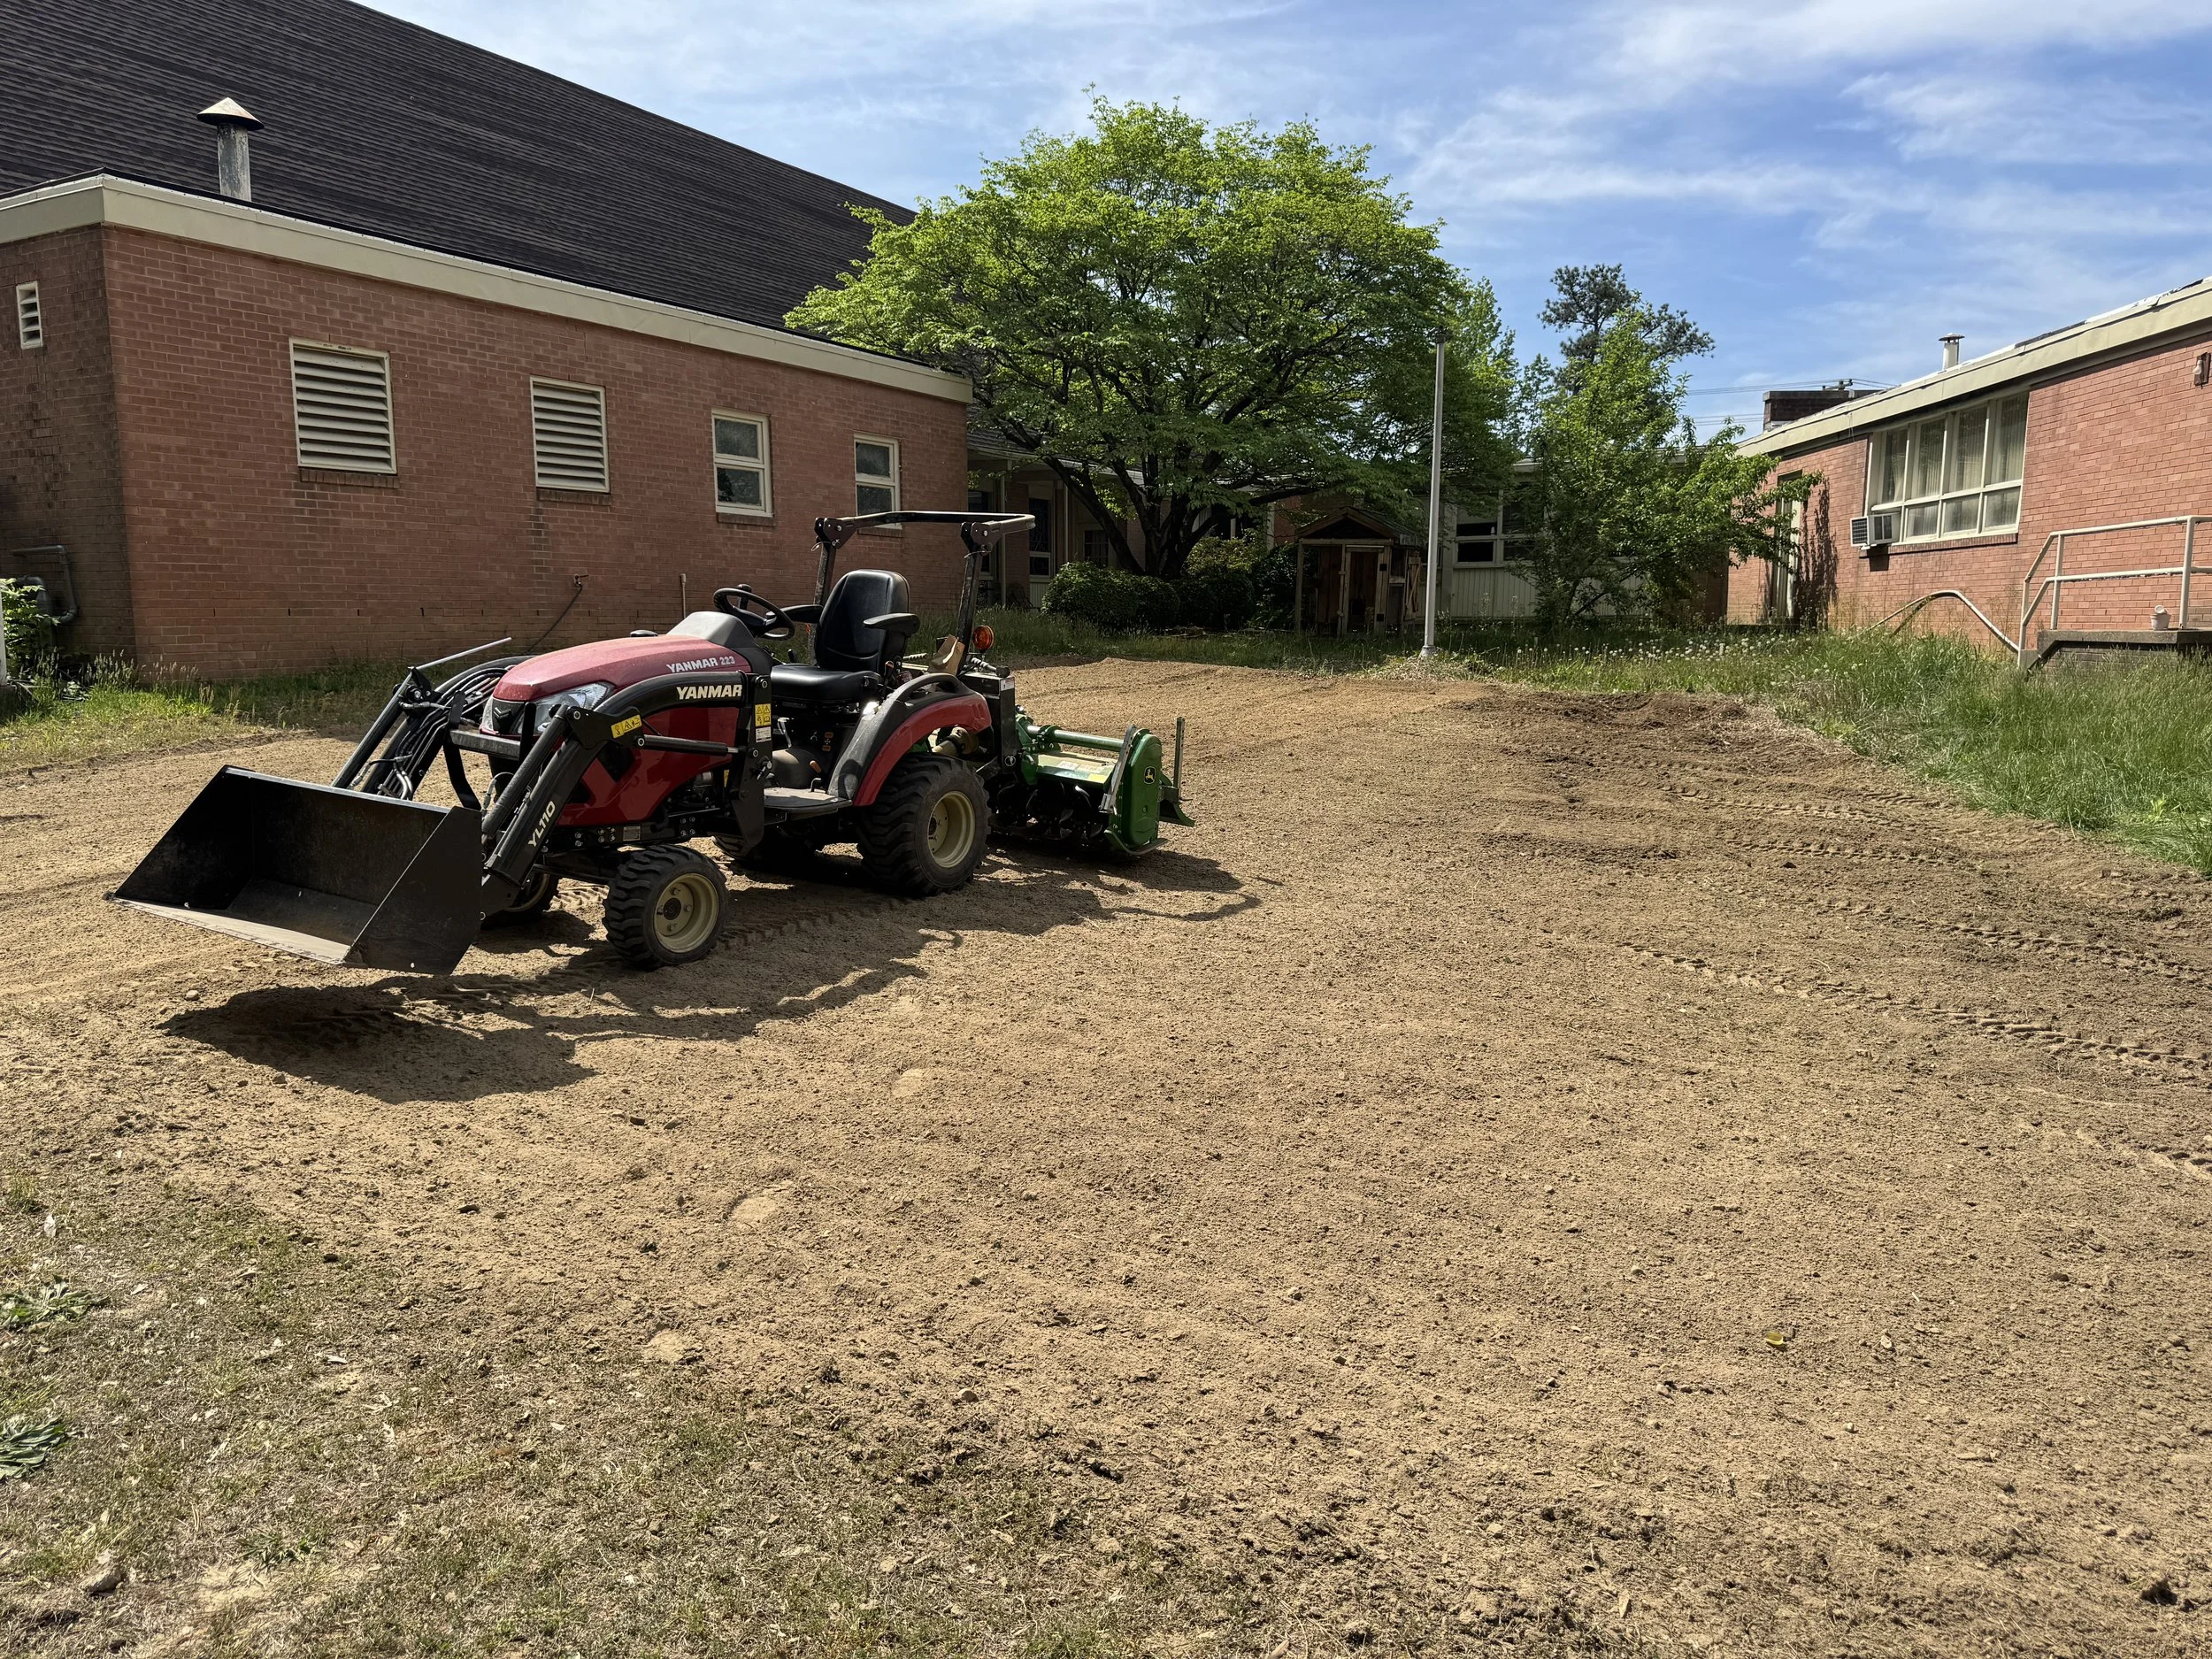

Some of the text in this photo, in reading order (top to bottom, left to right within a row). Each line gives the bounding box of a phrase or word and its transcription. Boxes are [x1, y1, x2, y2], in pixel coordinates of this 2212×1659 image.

[666, 656, 735, 672] YANMAR 223
[677, 685, 742, 700] YANMAR
[528, 801, 556, 847] YL110
